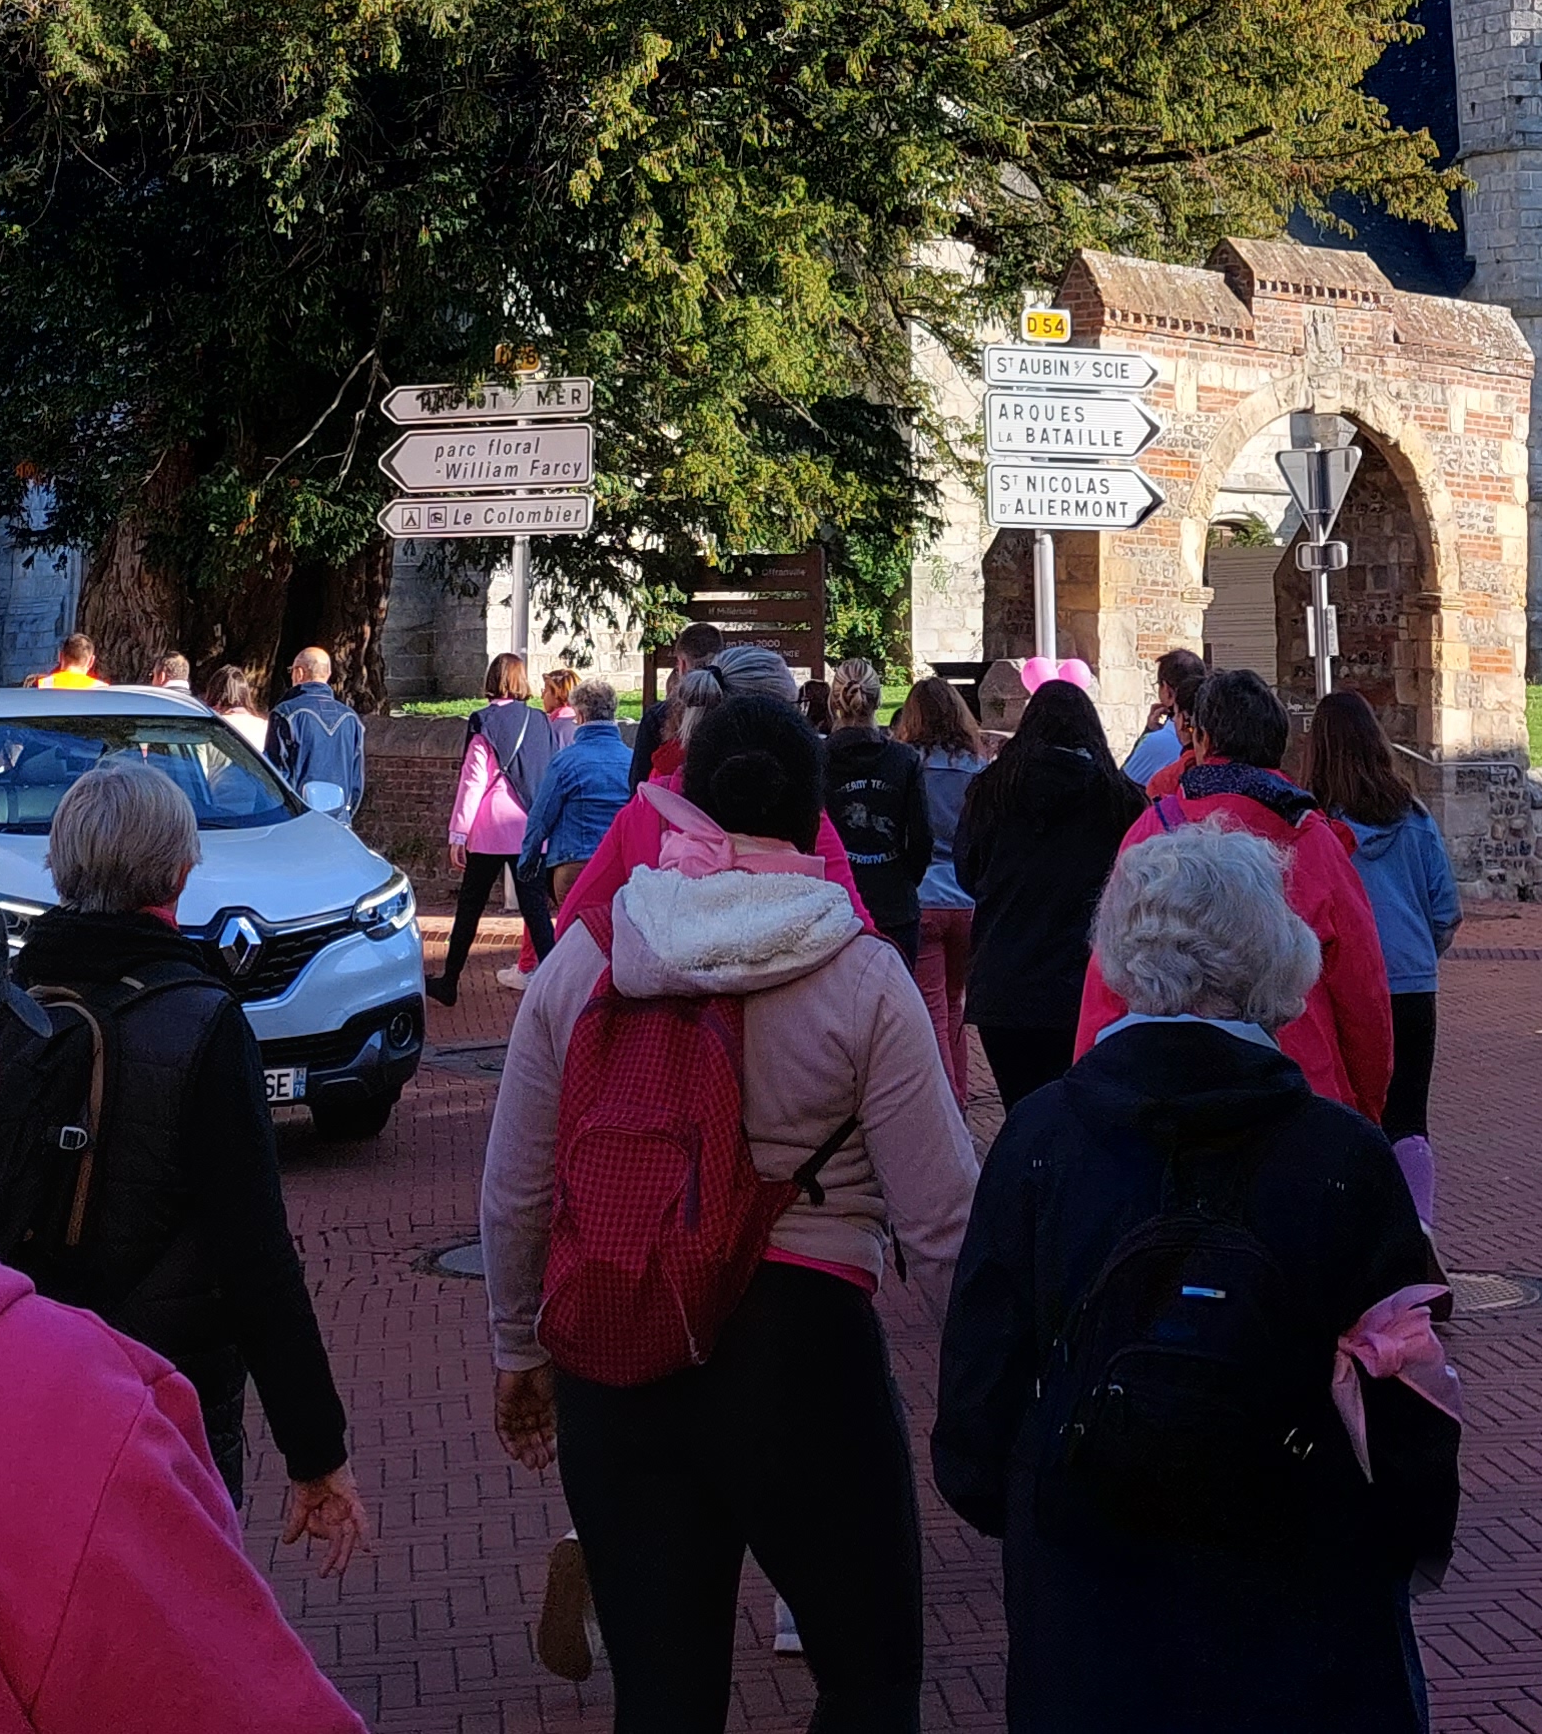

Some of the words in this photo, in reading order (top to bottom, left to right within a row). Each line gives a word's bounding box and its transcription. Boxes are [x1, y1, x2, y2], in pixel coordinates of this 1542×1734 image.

[1027, 317, 1037, 334] D
[1042, 317, 1065, 335] 54
[1019, 358, 1070, 377] AUBIN
[1092, 361, 1130, 380] SCIE
[999, 403, 1085, 423] ARQUES
[998, 431, 1013, 443] LA
[1026, 427, 1123, 447] BATAILLE
[434, 443, 477, 463] parc
[488, 436, 541, 456] floral
[530, 459, 582, 479] Farcy
[1027, 475, 1110, 495] NICOLAS
[453, 508, 473, 526] Le
[484, 505, 581, 525] Colombier
